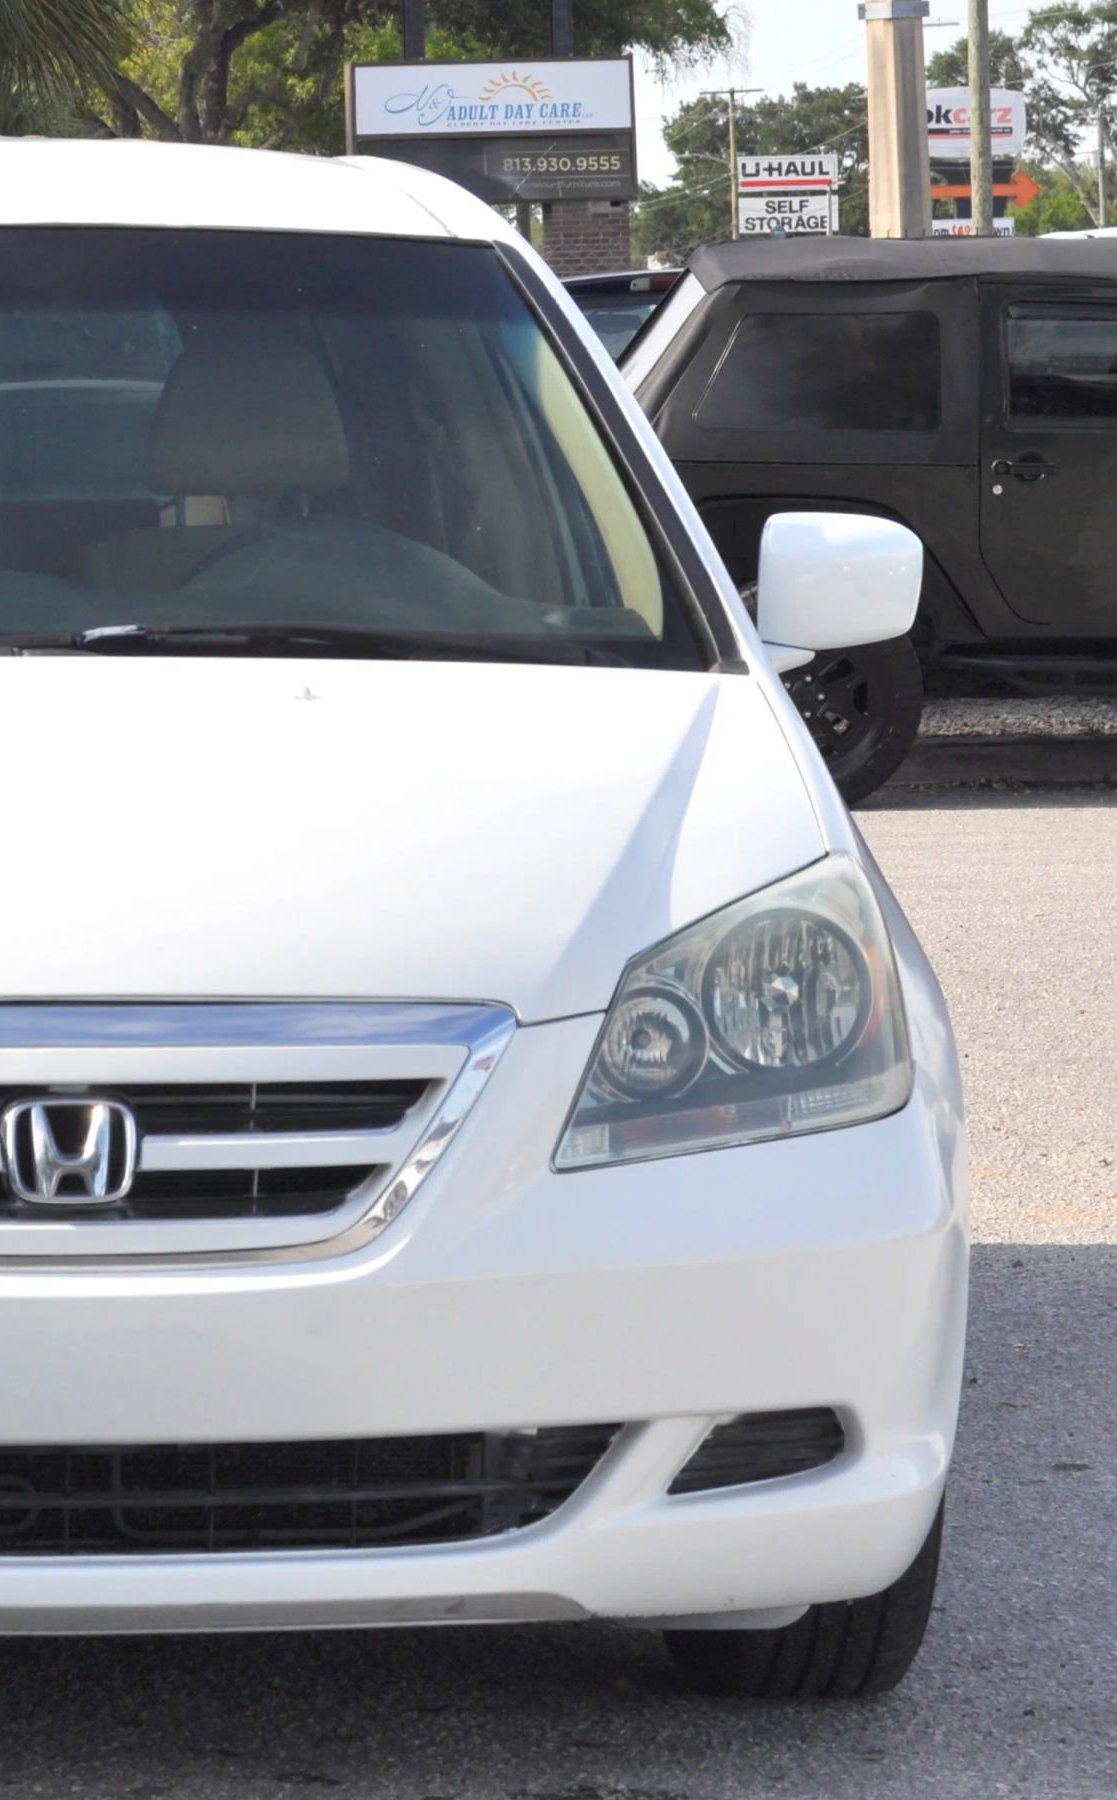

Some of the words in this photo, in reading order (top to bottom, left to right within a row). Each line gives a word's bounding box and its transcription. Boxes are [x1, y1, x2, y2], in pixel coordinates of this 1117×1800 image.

[446, 104, 499, 121] ADULT
[504, 103, 534, 119] DAY
[540, 102, 582, 118] CARE
[503, 156, 621, 172] 813.930.9555
[741, 161, 830, 177] U-HAUL
[765, 199, 809, 215] SELF
[744, 215, 828, 231] STORAGE
